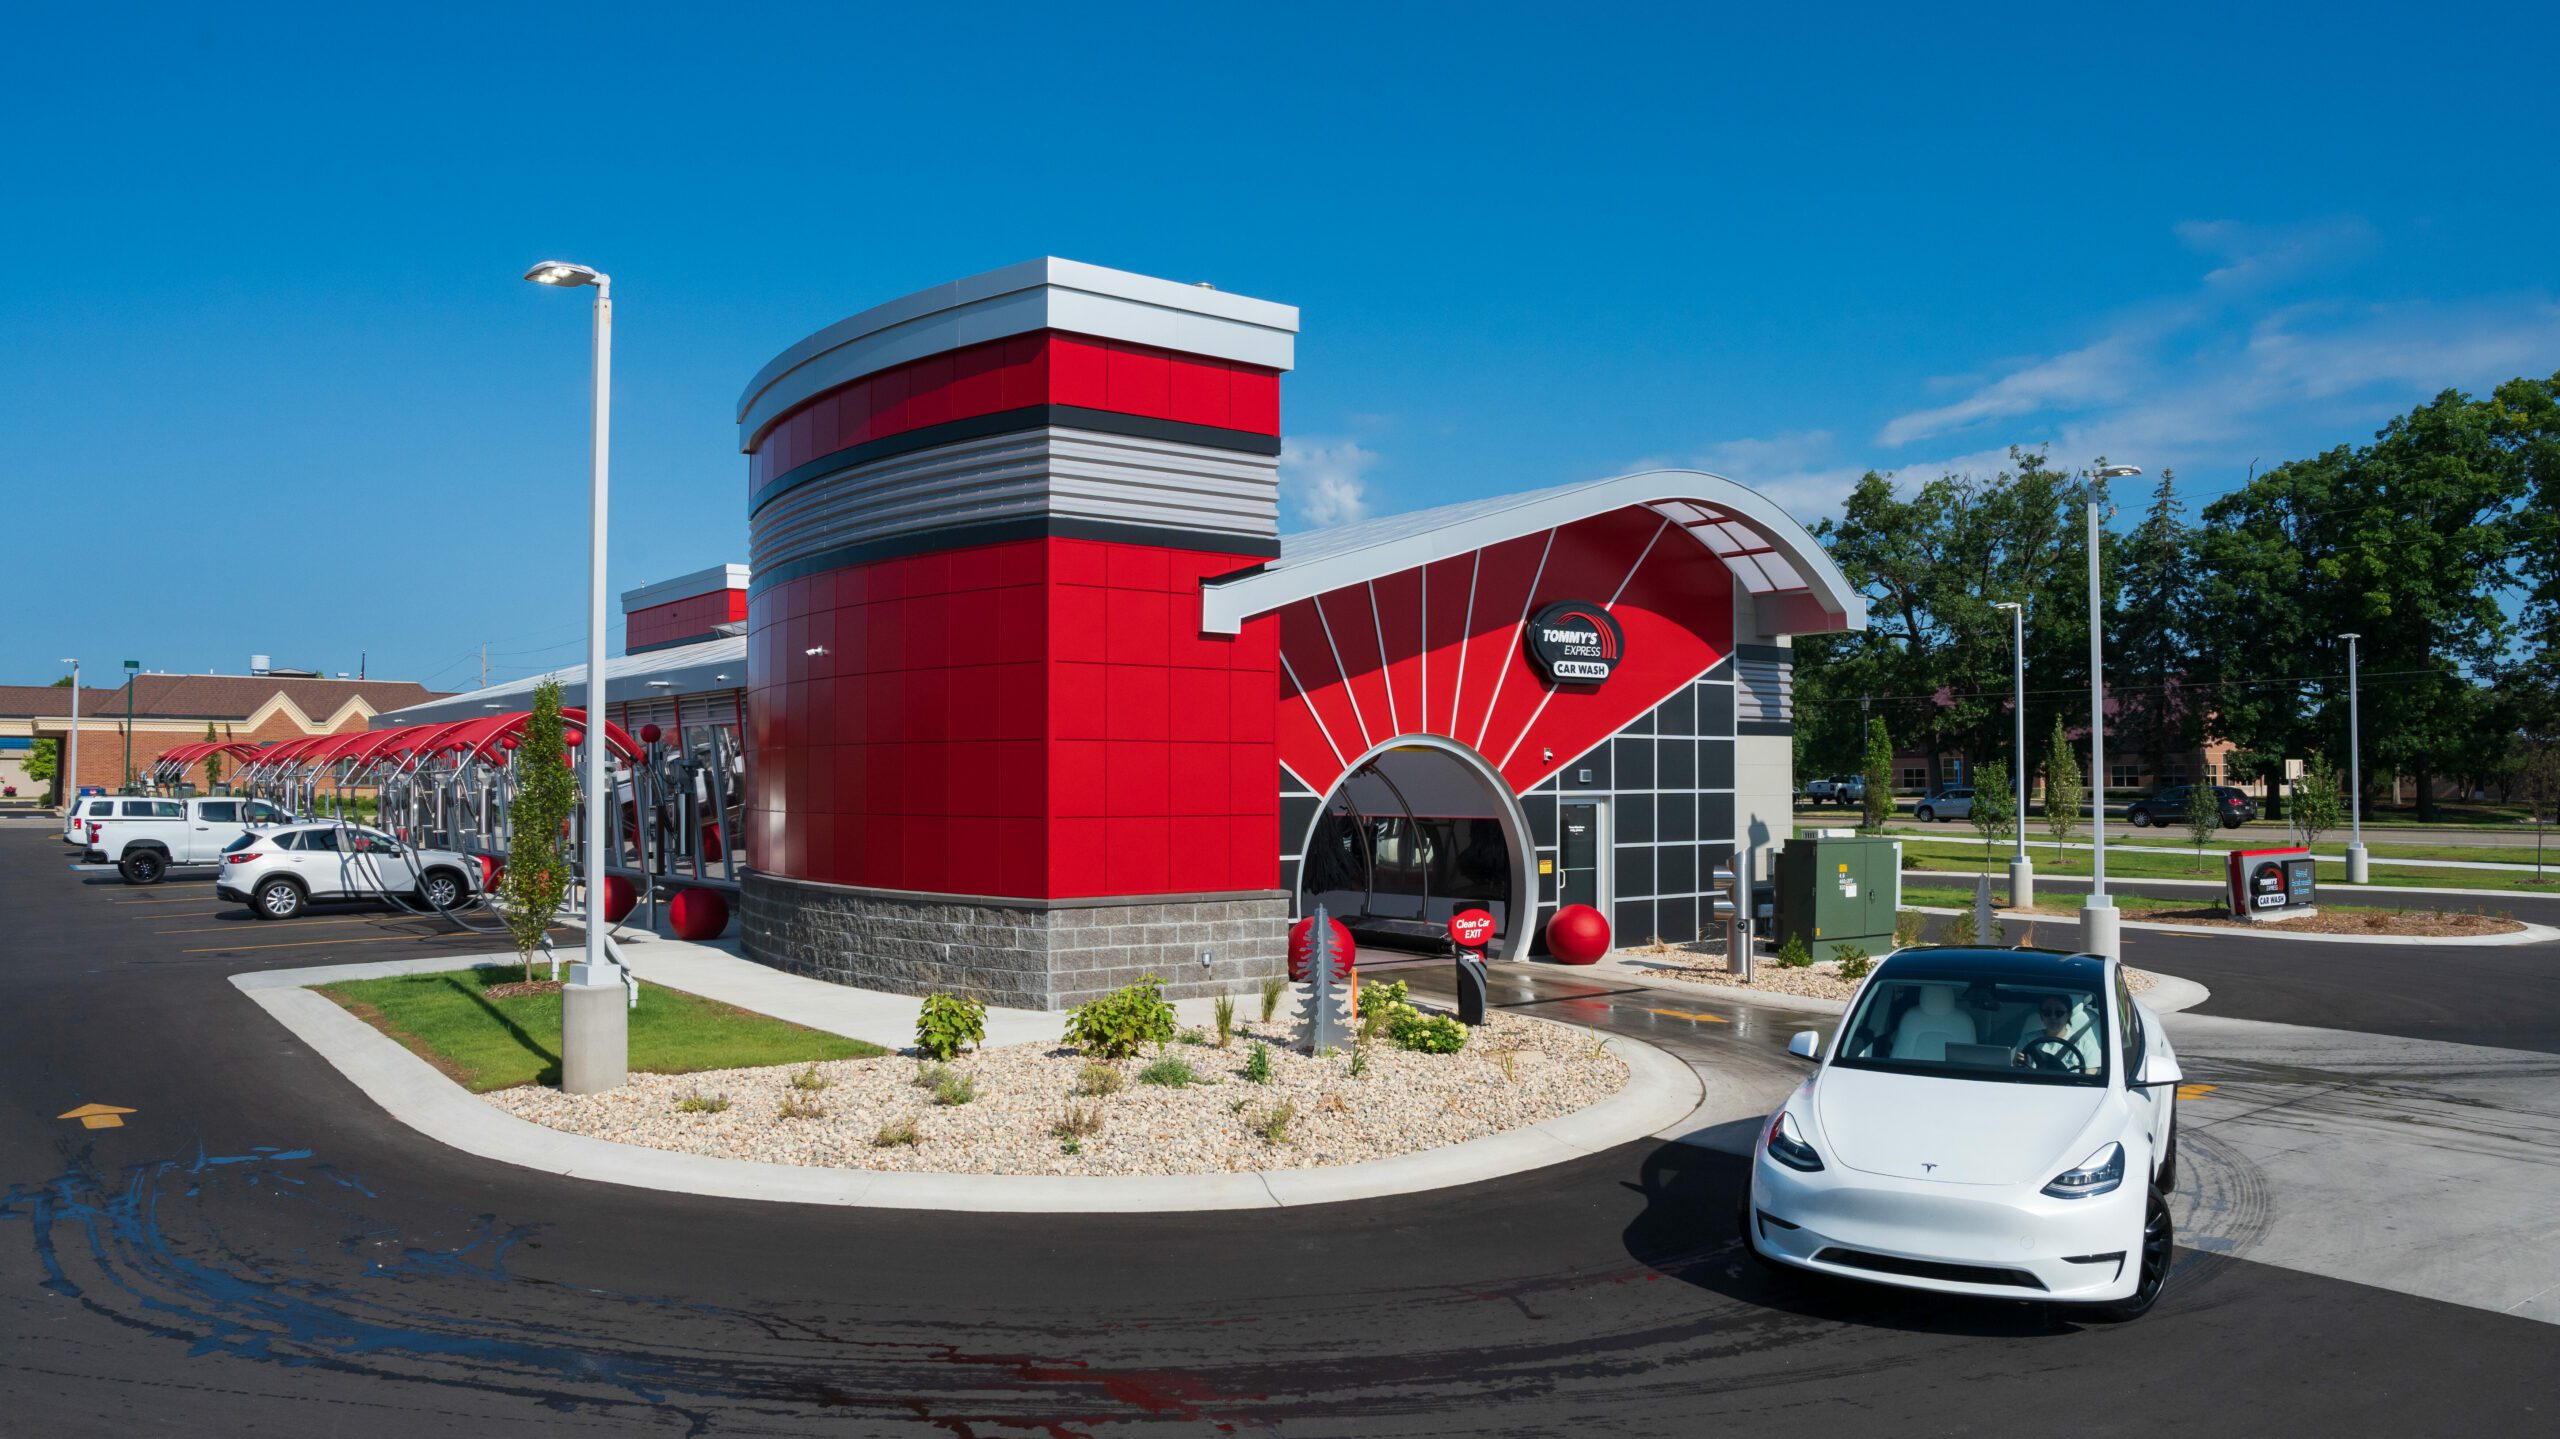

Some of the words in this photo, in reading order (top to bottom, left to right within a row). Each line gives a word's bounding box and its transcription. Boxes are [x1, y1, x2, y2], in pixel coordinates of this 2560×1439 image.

[1543, 629, 1598, 645] TOMMY'S
[1564, 645, 1601, 657] EXPRESS
[1557, 664, 1576, 674] CAR
[1578, 664, 1605, 675] WASH
[2259, 896, 2269, 905] CAR
[1456, 919, 1477, 929] Clean
[1478, 918, 1490, 928] Car
[1465, 929, 1482, 939] EXIT
